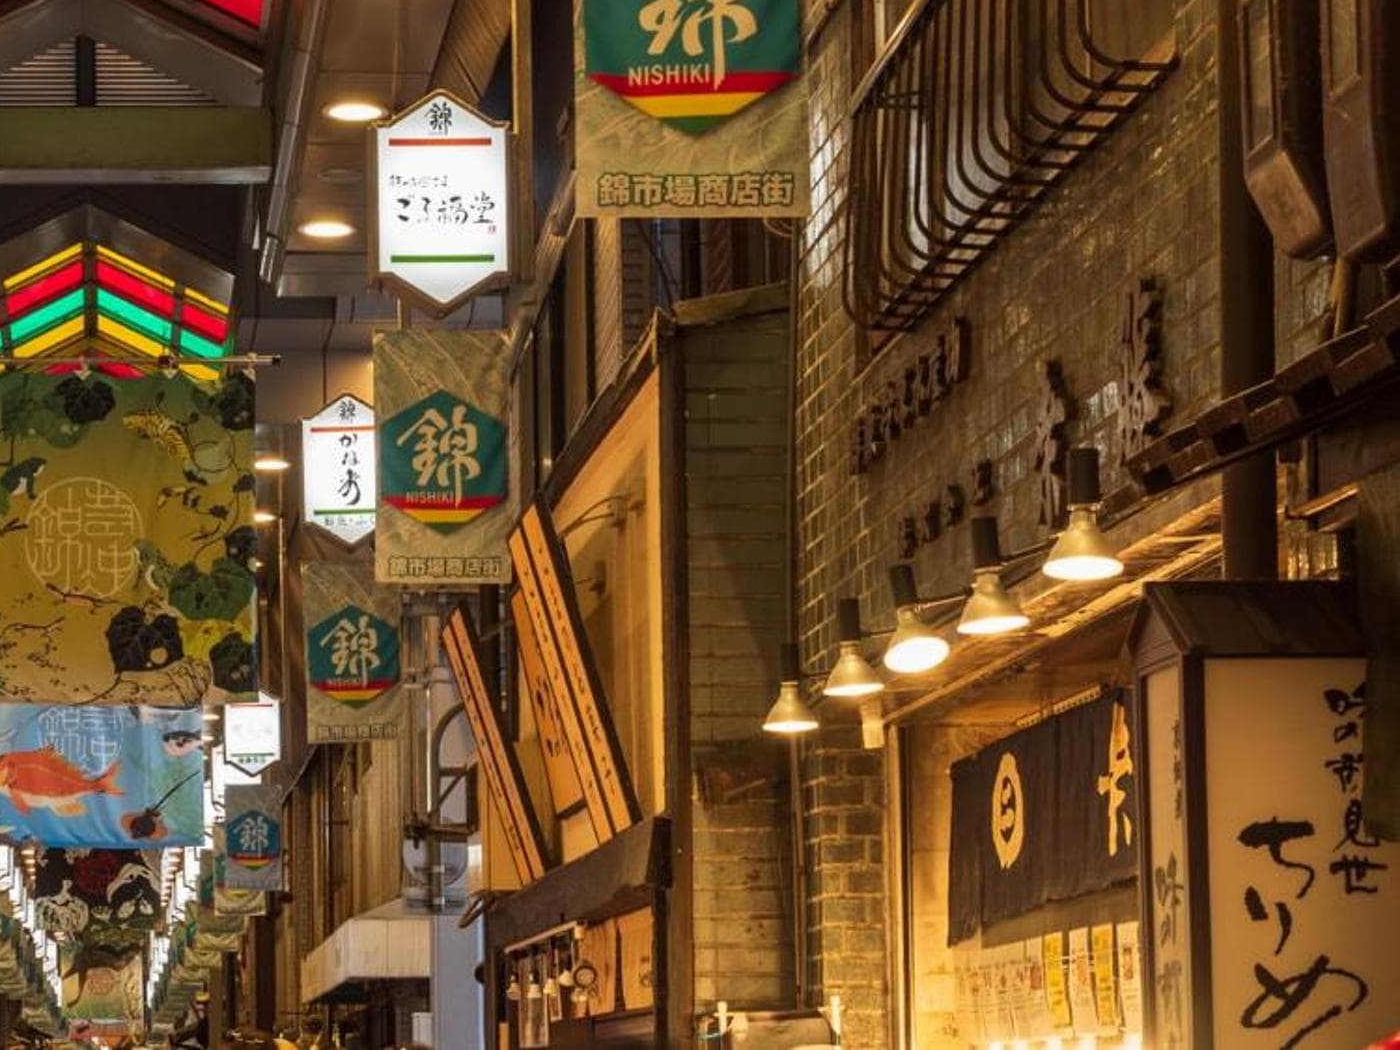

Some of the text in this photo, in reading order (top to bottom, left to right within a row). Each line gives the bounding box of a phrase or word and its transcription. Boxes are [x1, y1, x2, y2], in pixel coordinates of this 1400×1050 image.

[628, 62, 711, 87] NISHIKI
[597, 171, 794, 207] 錦市場商店街
[396, 404, 482, 509] 錦
[406, 491, 454, 505] NISHIKI
[389, 556, 502, 578] 錦市場商店街
[320, 615, 381, 689] 錦
